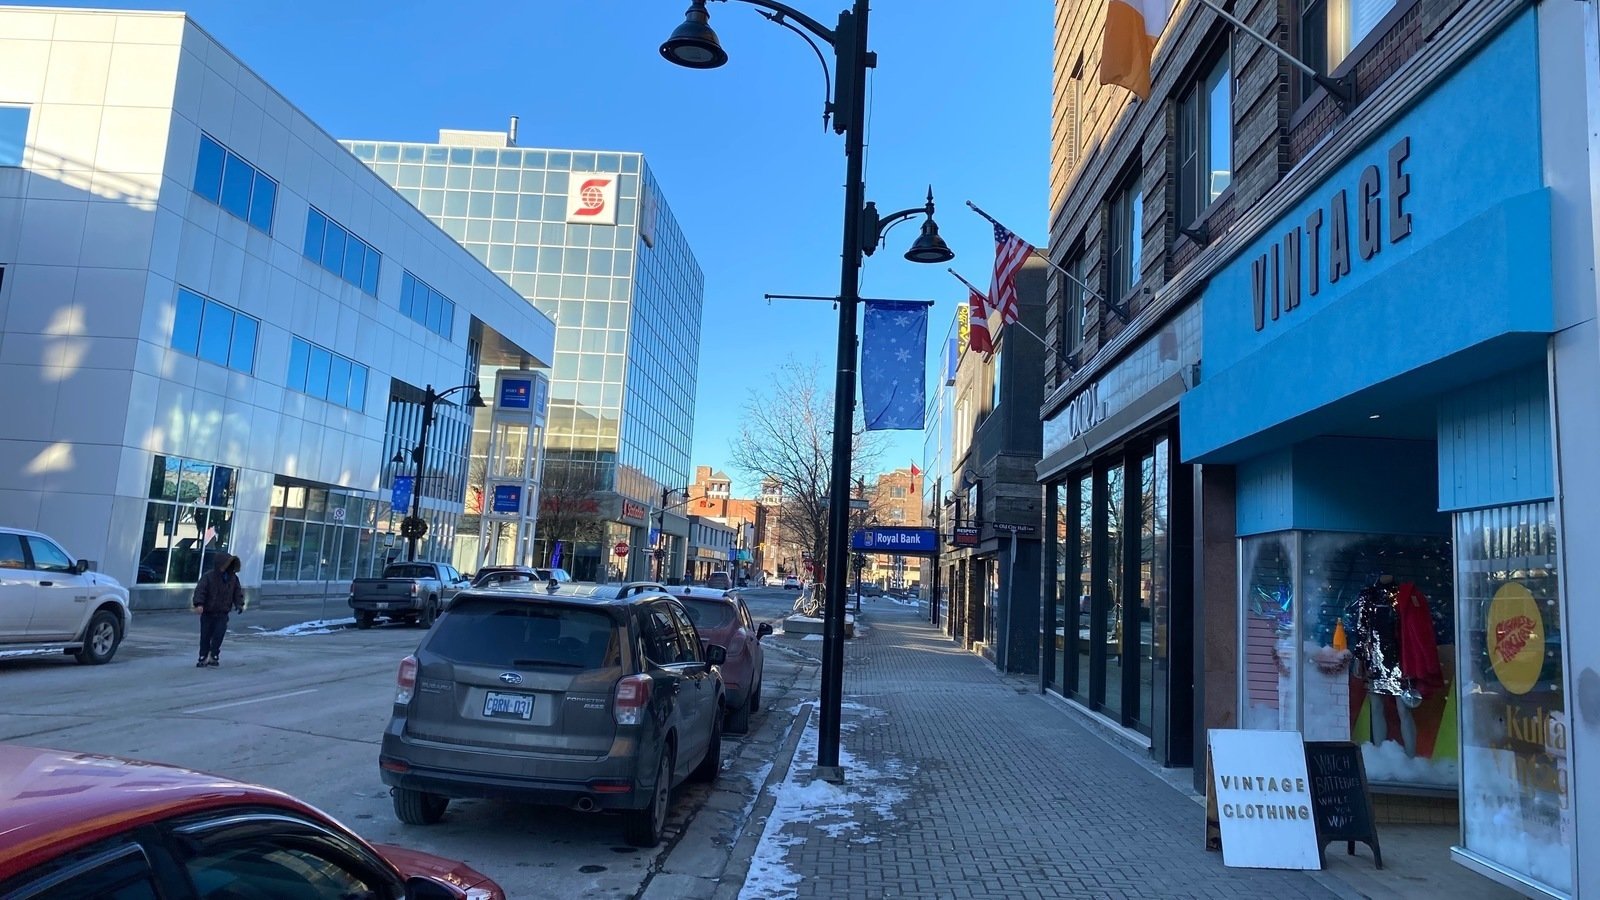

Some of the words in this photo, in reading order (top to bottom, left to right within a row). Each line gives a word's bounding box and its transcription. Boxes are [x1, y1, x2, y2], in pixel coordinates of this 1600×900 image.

[1251, 136, 1412, 332] VINTAGE
[877, 533, 899, 545] Royal
[900, 533, 921, 544] Bank
[1313, 754, 1350, 775] WATCH
[1220, 775, 1305, 793] VINTAGE
[1223, 803, 1310, 820] CLOTHING
[1327, 815, 1356, 828] WAIT
